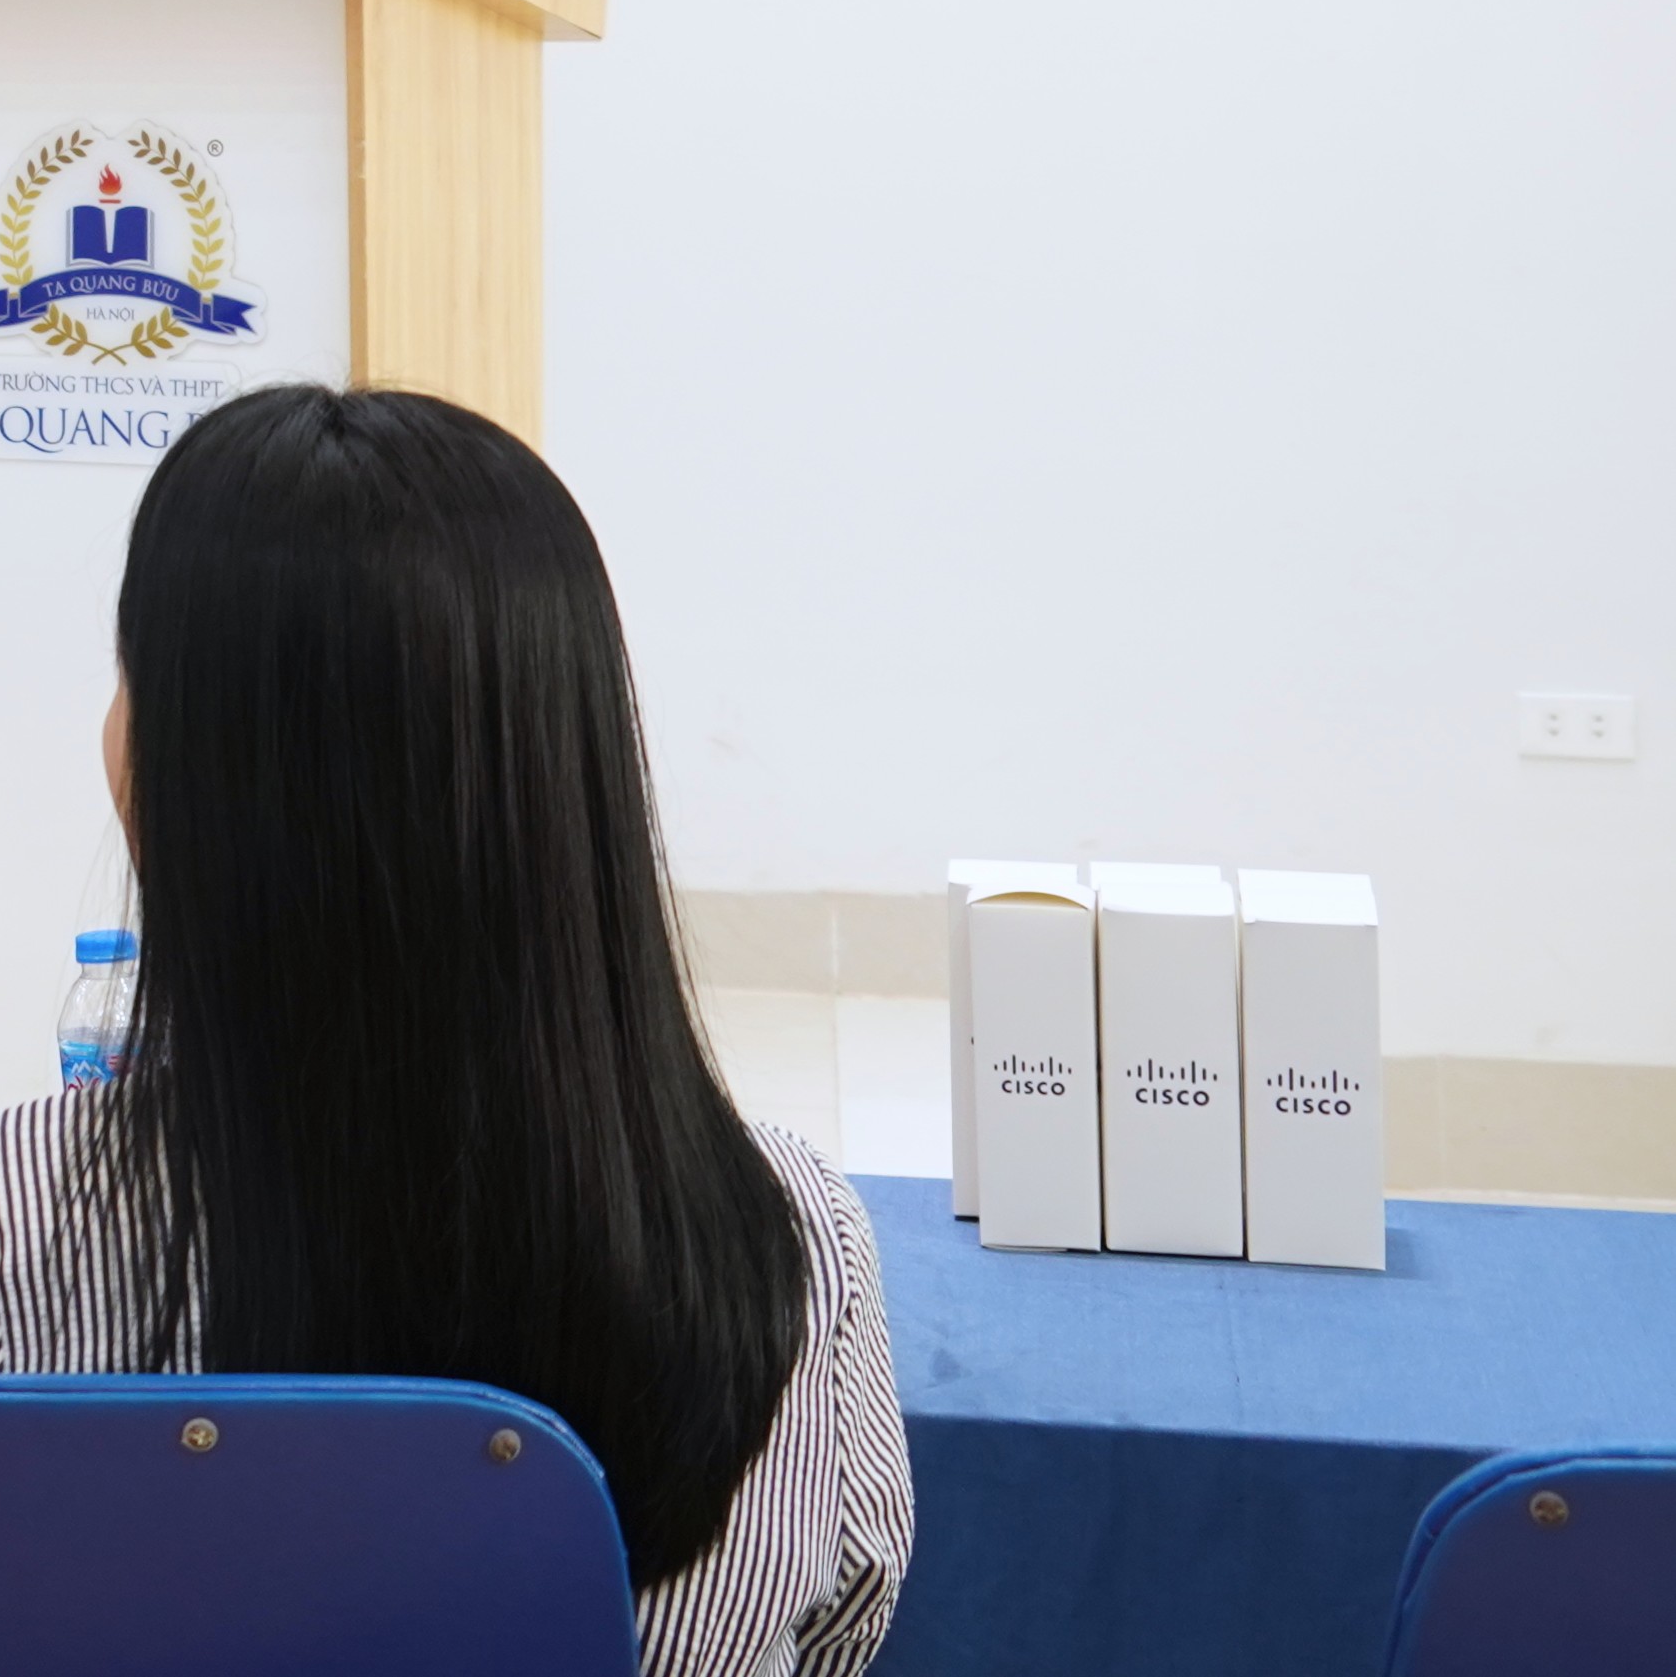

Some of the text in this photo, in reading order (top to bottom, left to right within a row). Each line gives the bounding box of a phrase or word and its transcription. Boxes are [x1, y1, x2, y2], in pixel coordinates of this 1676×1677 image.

[69, 274, 137, 294] QUANG
[86, 305, 106, 321] HÀ
[80, 375, 134, 396] THCS
[138, 374, 166, 397] VÀ
[168, 378, 224, 398] THPT
[1001, 1079, 1066, 1097] CISCO
[1135, 1087, 1211, 1107] CISCO
[1275, 1096, 1352, 1117] CISCO
